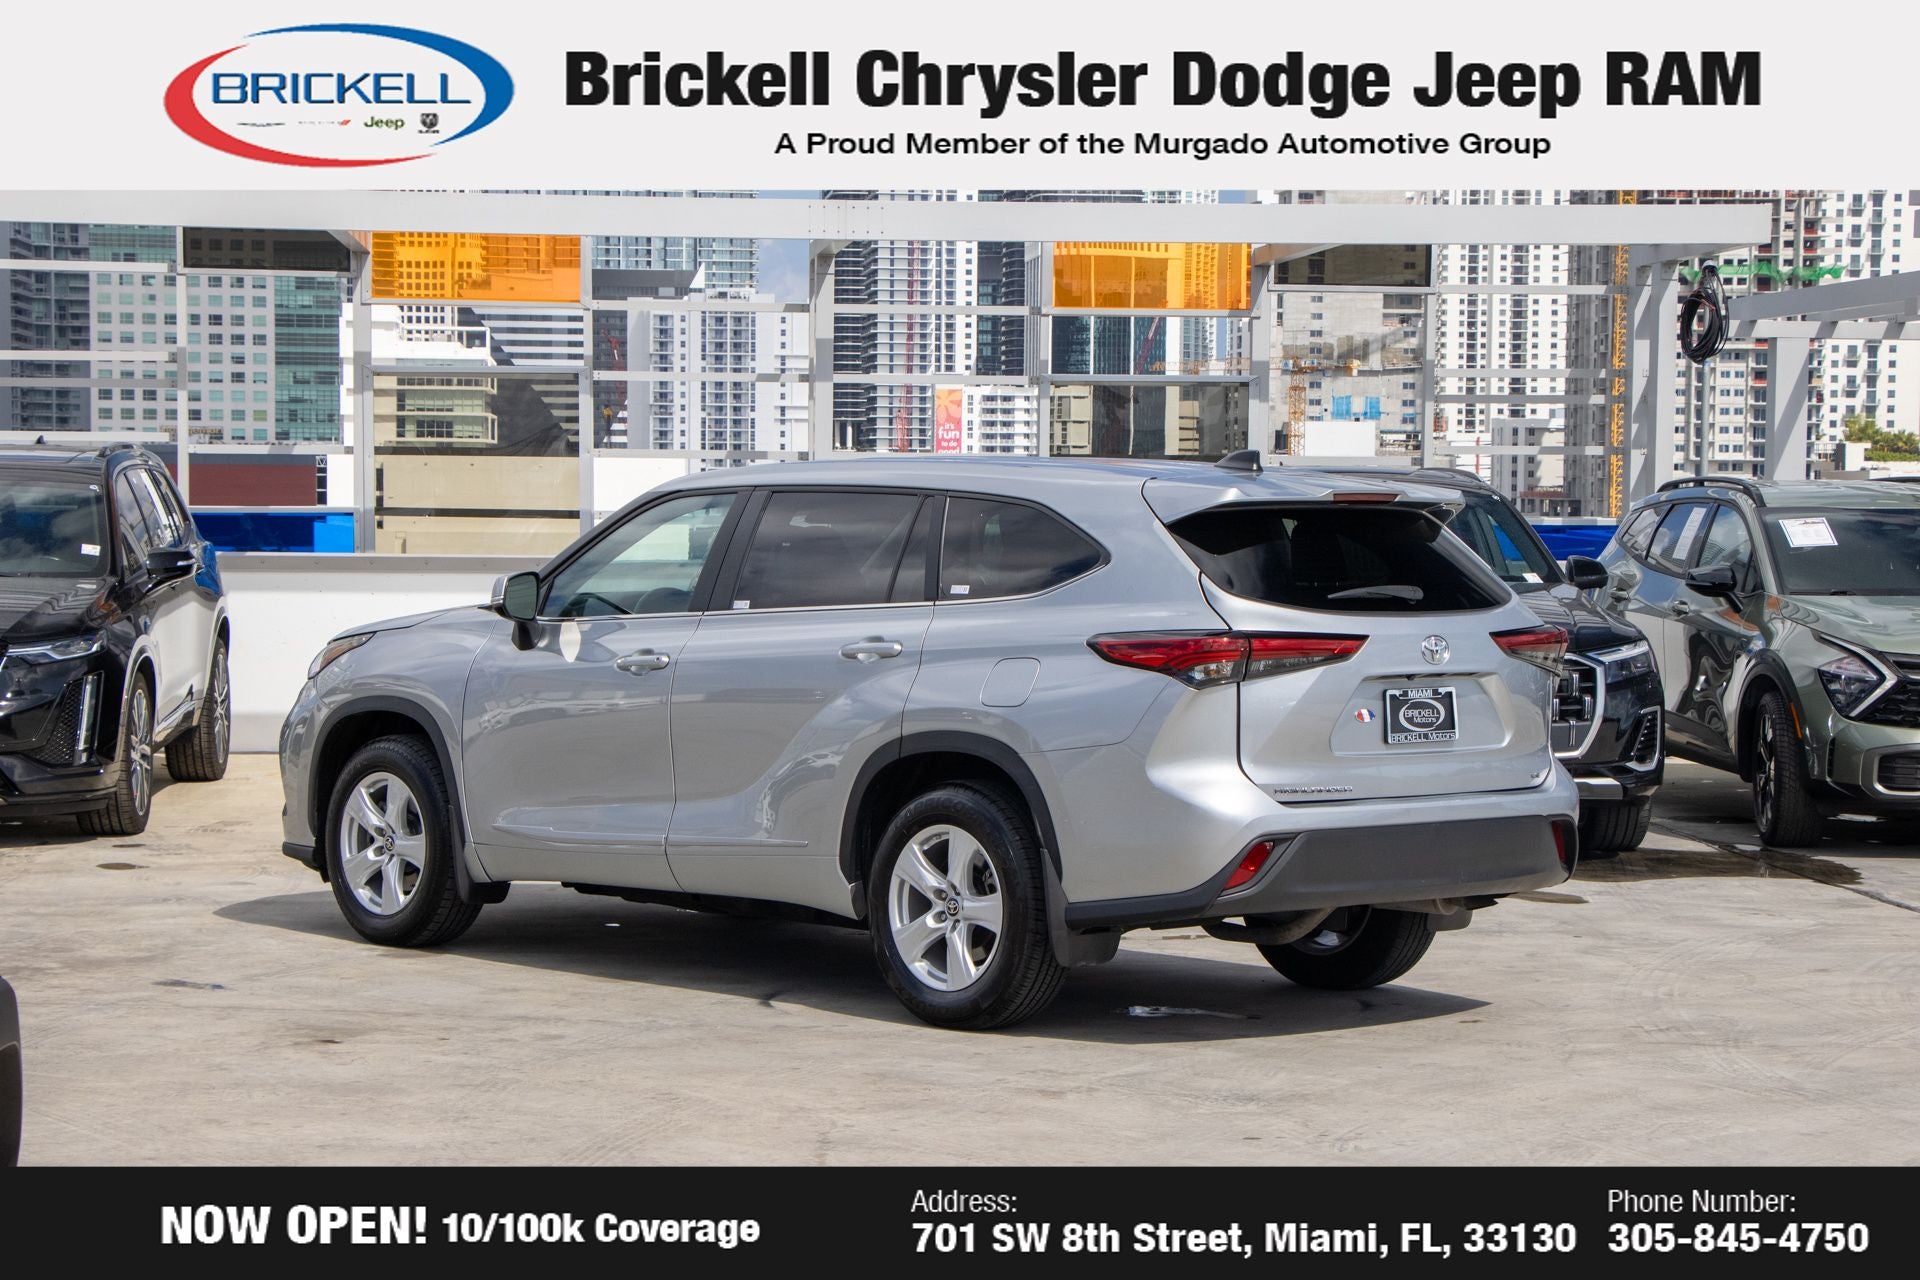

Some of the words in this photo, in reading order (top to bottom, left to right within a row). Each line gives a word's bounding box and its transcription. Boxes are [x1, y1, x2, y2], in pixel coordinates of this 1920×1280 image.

[938, 427, 960, 439] fun
[1408, 688, 1433, 698] MIAMI
[1404, 709, 1439, 718] BRICKELL
[1391, 733, 1426, 743] BRICKELL
[1428, 732, 1456, 741] Motors
